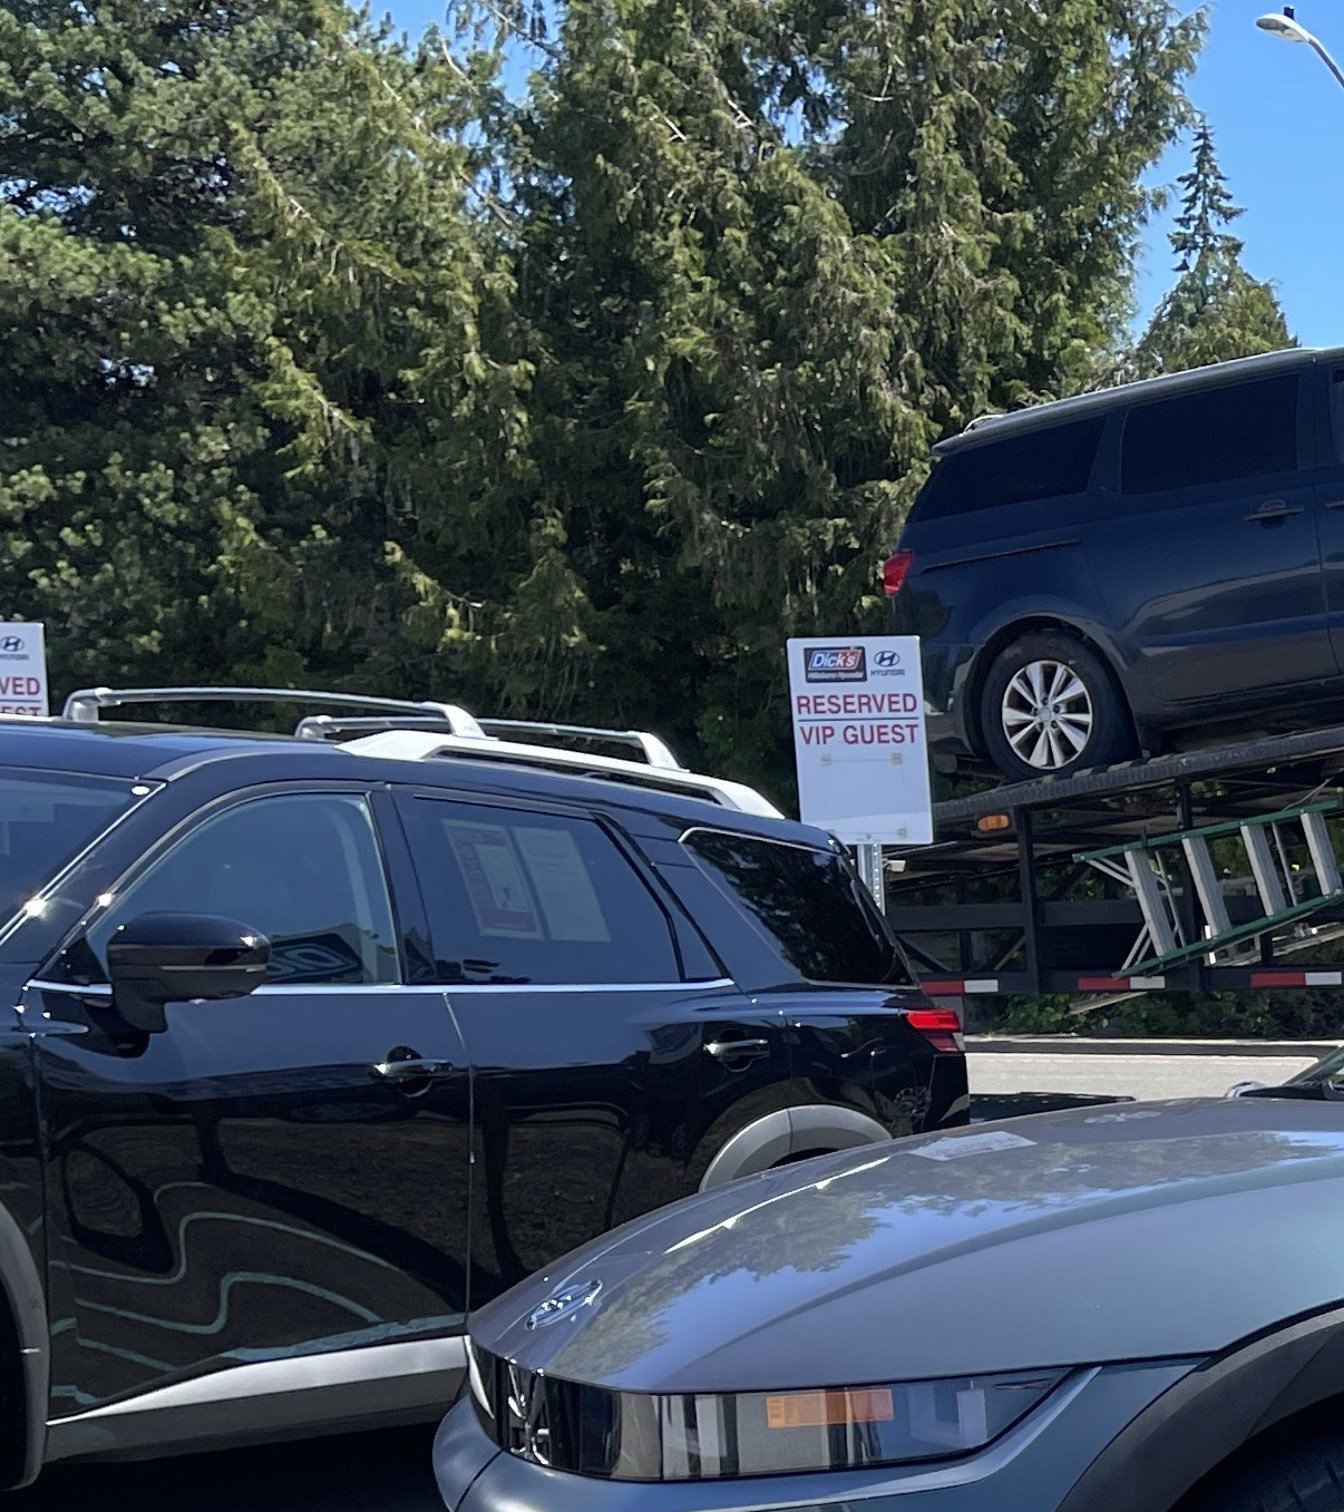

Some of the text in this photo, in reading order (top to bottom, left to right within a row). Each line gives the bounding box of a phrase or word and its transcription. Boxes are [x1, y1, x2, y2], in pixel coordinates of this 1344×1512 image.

[796, 693, 918, 714] RESERVED
[800, 723, 919, 745] VIP GUEST
